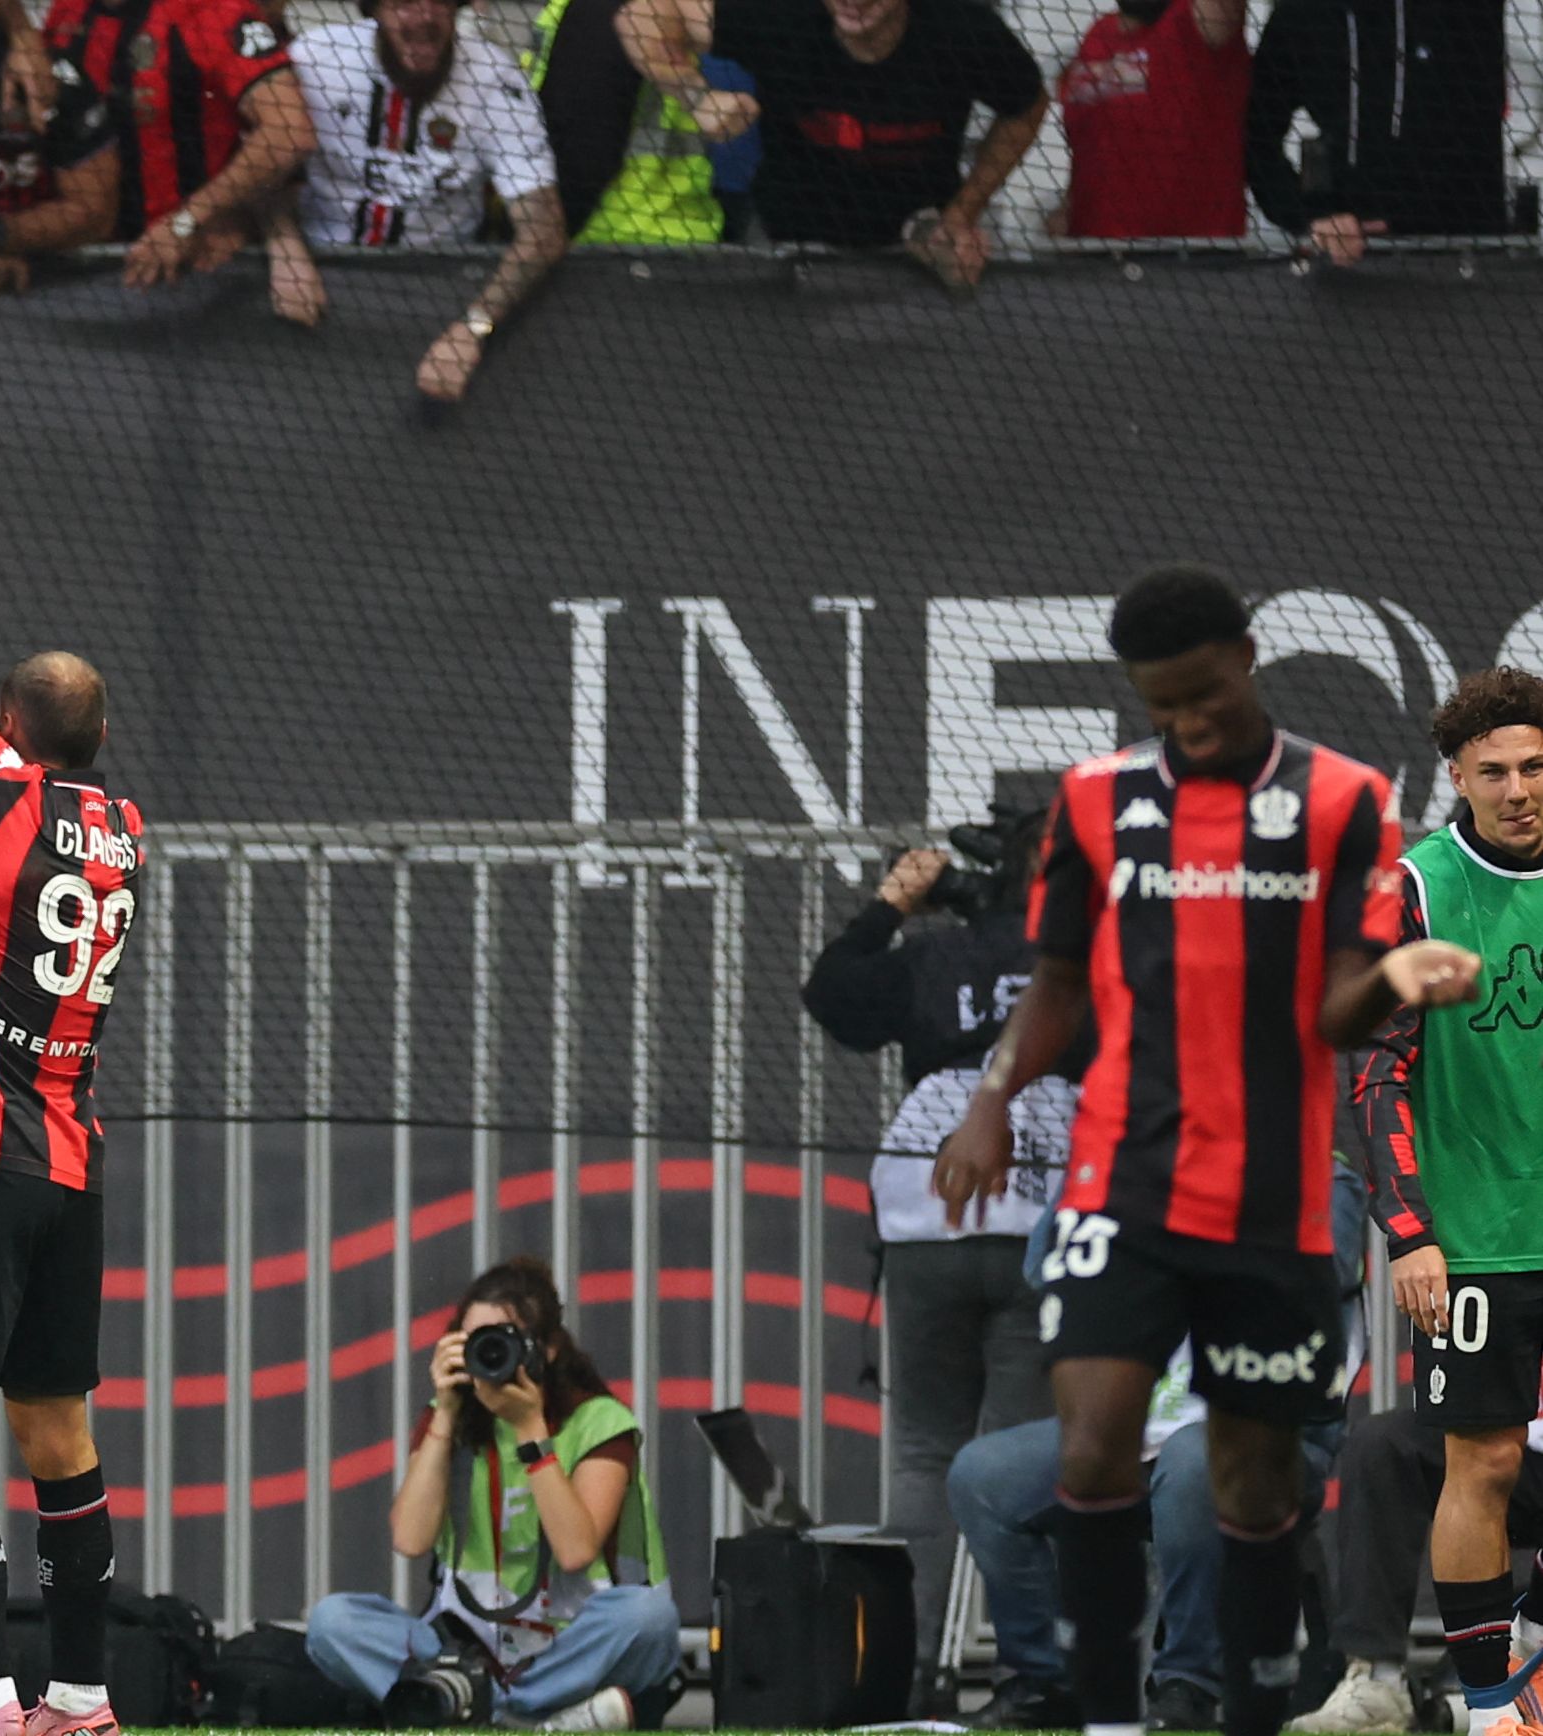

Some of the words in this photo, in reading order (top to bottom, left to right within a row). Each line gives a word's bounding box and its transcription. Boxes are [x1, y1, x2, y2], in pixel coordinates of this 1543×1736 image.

[550, 588, 1543, 888] INEO
[56, 818, 138, 871] CLAUSS
[1139, 861, 1320, 901] Robinhood
[33, 873, 136, 1005] 92
[1205, 1343, 1317, 1383] vbet
